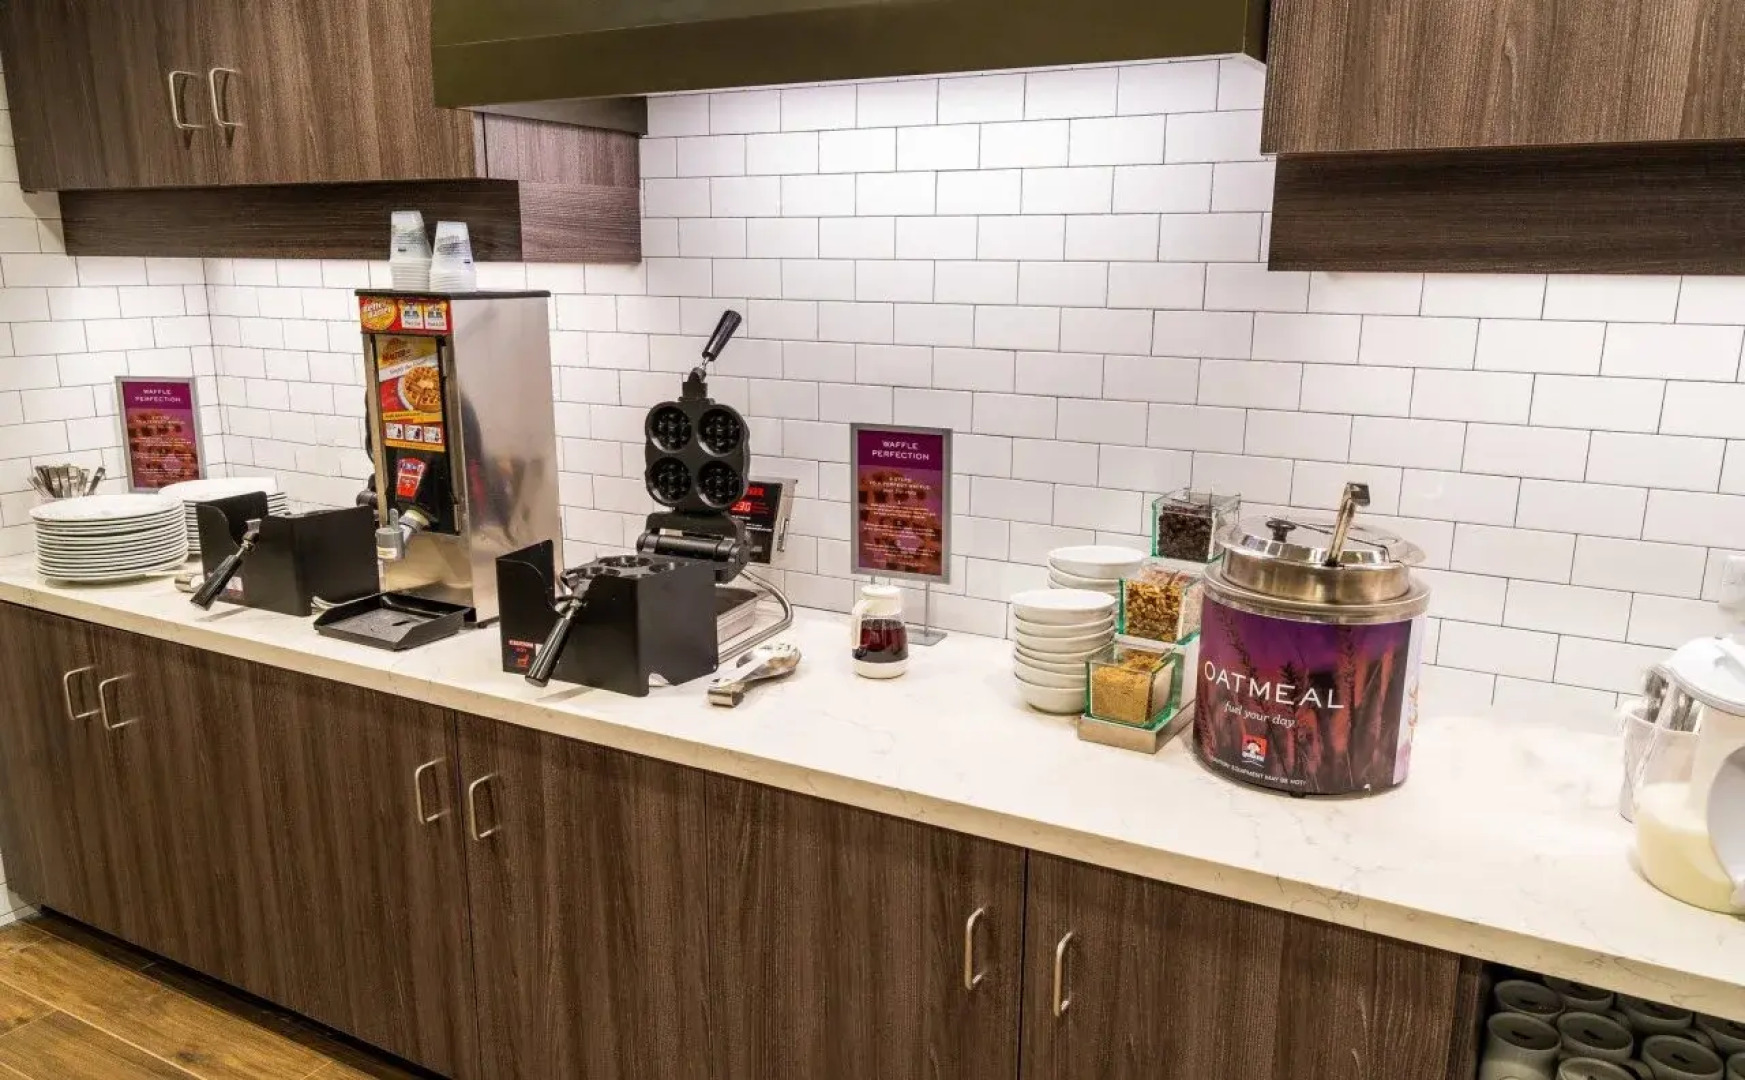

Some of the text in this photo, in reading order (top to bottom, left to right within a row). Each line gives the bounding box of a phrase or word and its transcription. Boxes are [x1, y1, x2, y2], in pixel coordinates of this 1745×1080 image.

[882, 441, 919, 450] WAFFLE
[871, 449, 930, 461] PERFECTION
[1204, 661, 1345, 709] OATMEAL
[1224, 701, 1296, 728] fuel your day
[1264, 774, 1280, 782] MAY
